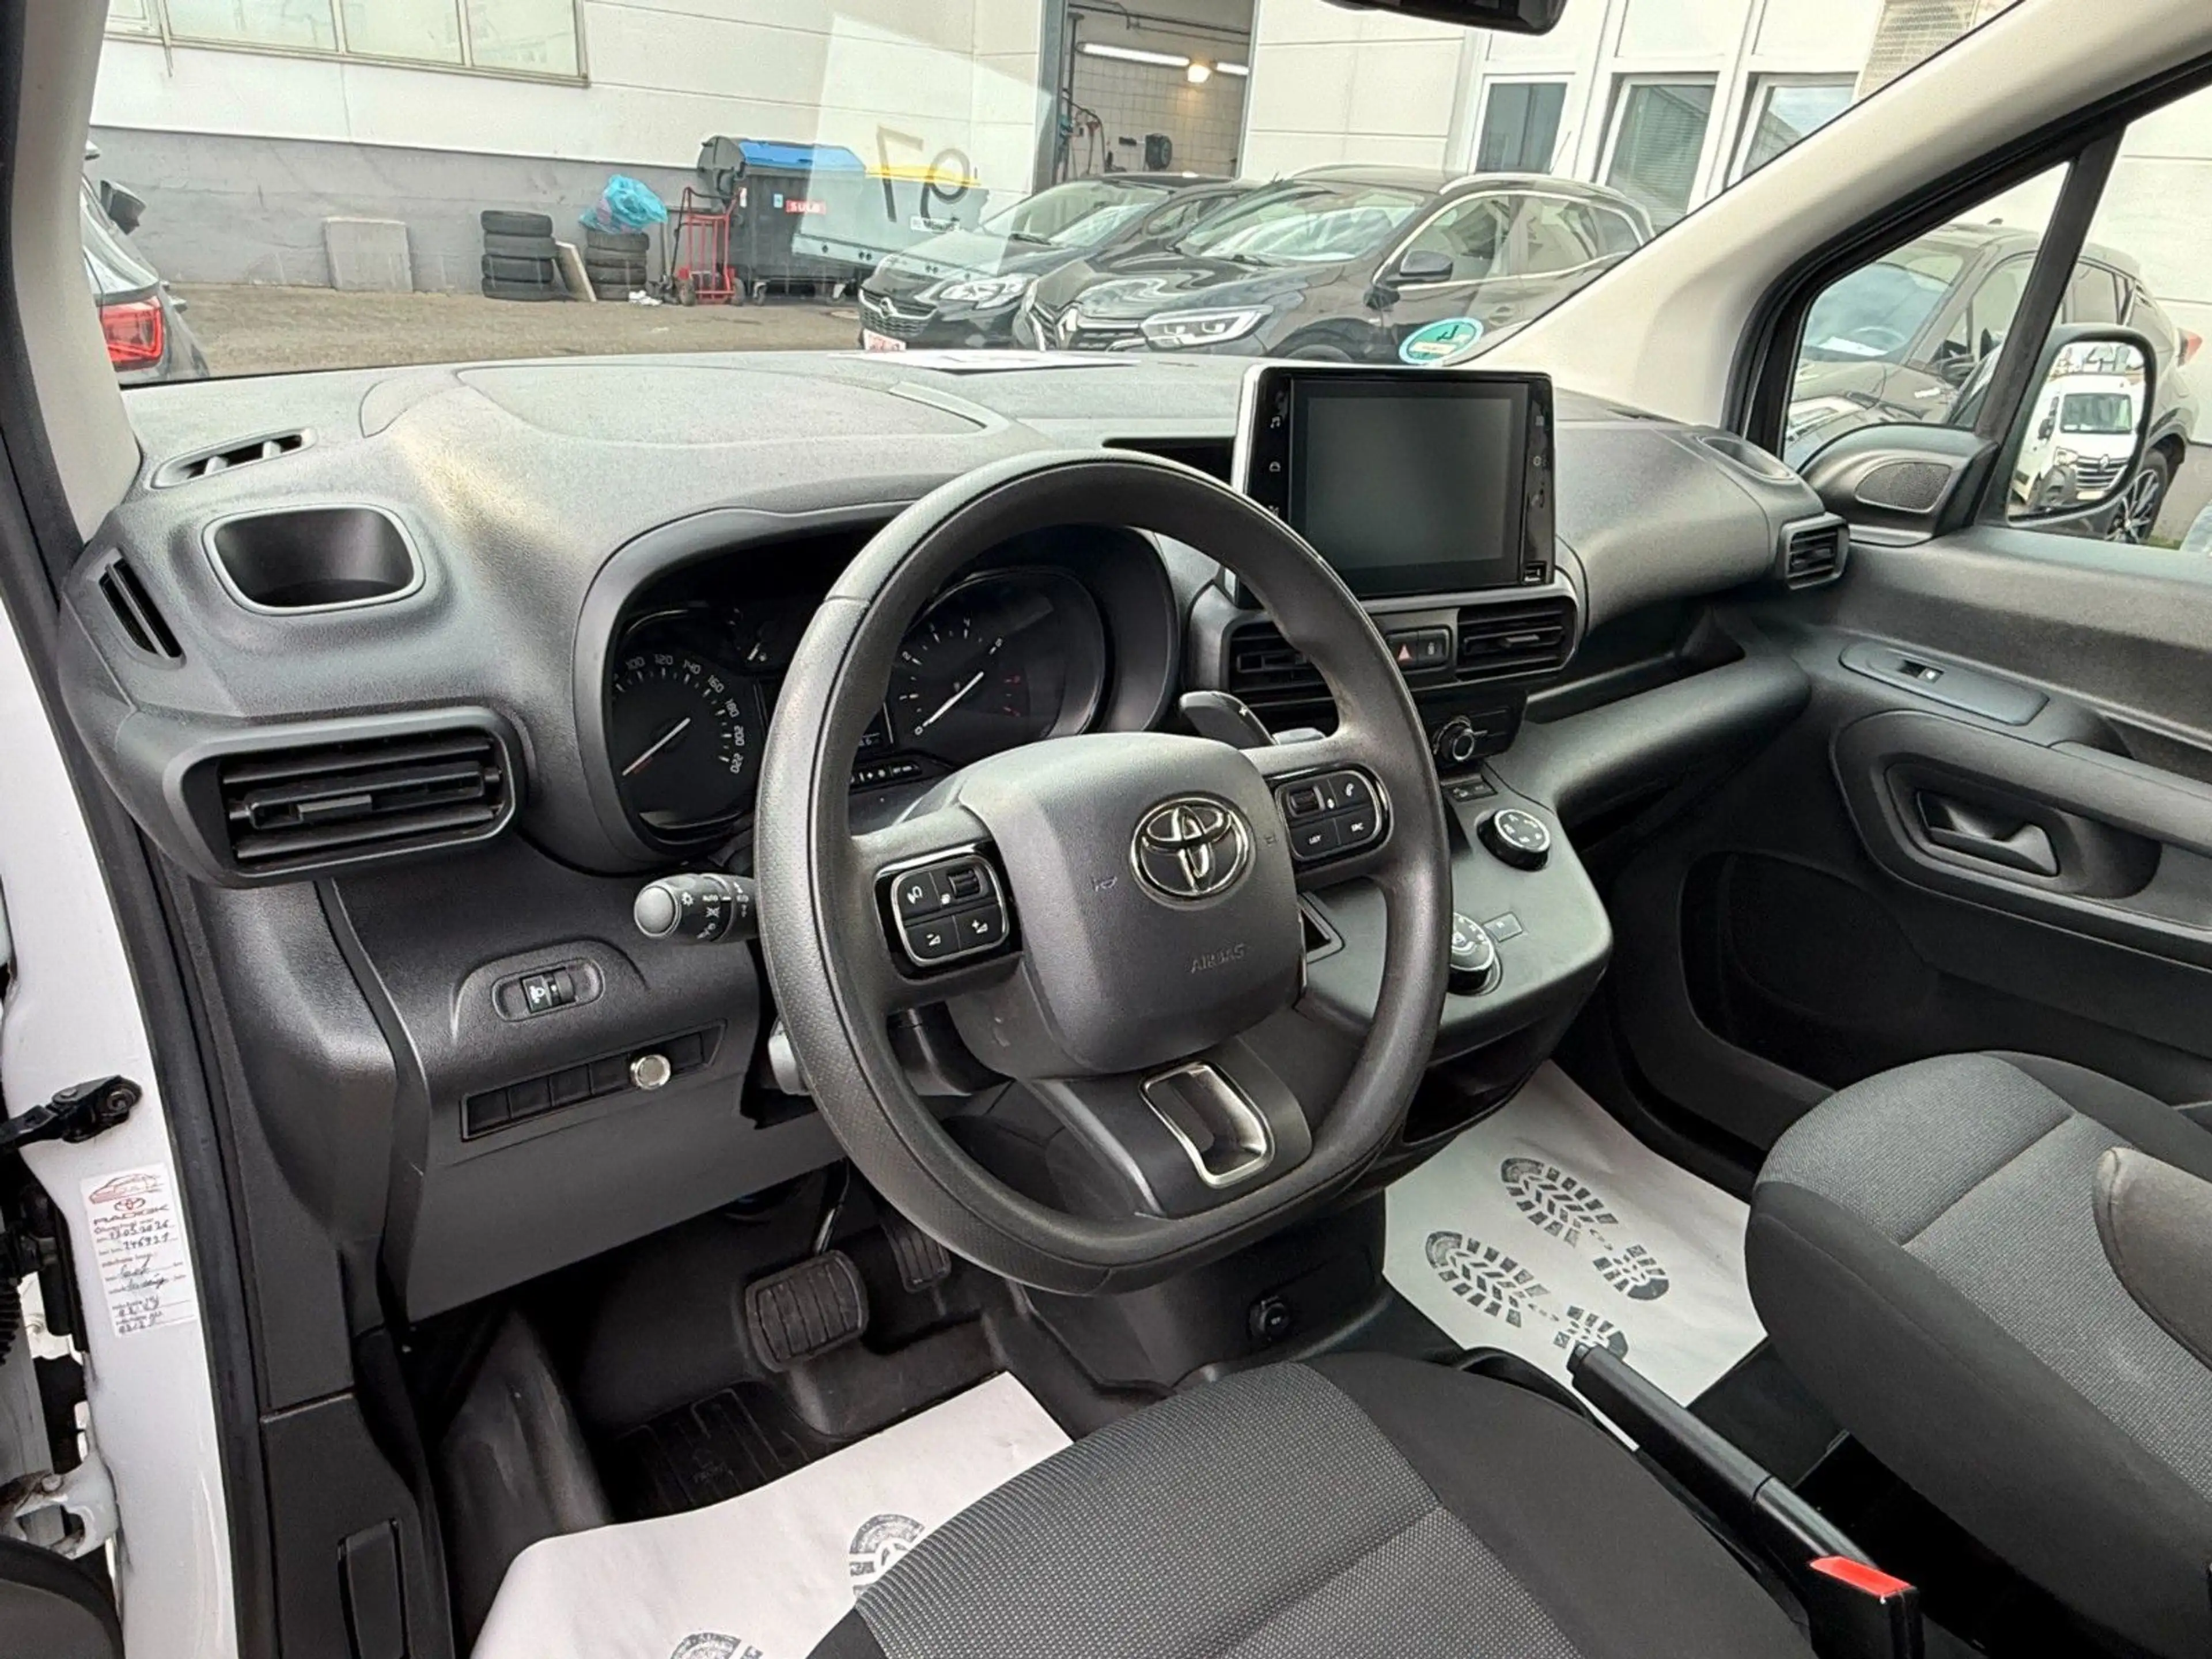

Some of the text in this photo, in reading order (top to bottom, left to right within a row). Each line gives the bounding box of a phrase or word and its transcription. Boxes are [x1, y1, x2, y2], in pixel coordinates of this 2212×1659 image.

[626, 656, 645, 670] 100
[654, 654, 673, 665] 120
[683, 659, 701, 675] 140
[708, 675, 724, 693] 160
[725, 698, 740, 718] 180
[734, 725, 745, 746] 200
[915, 726, 923, 735] 0
[730, 753, 744, 774] 220
